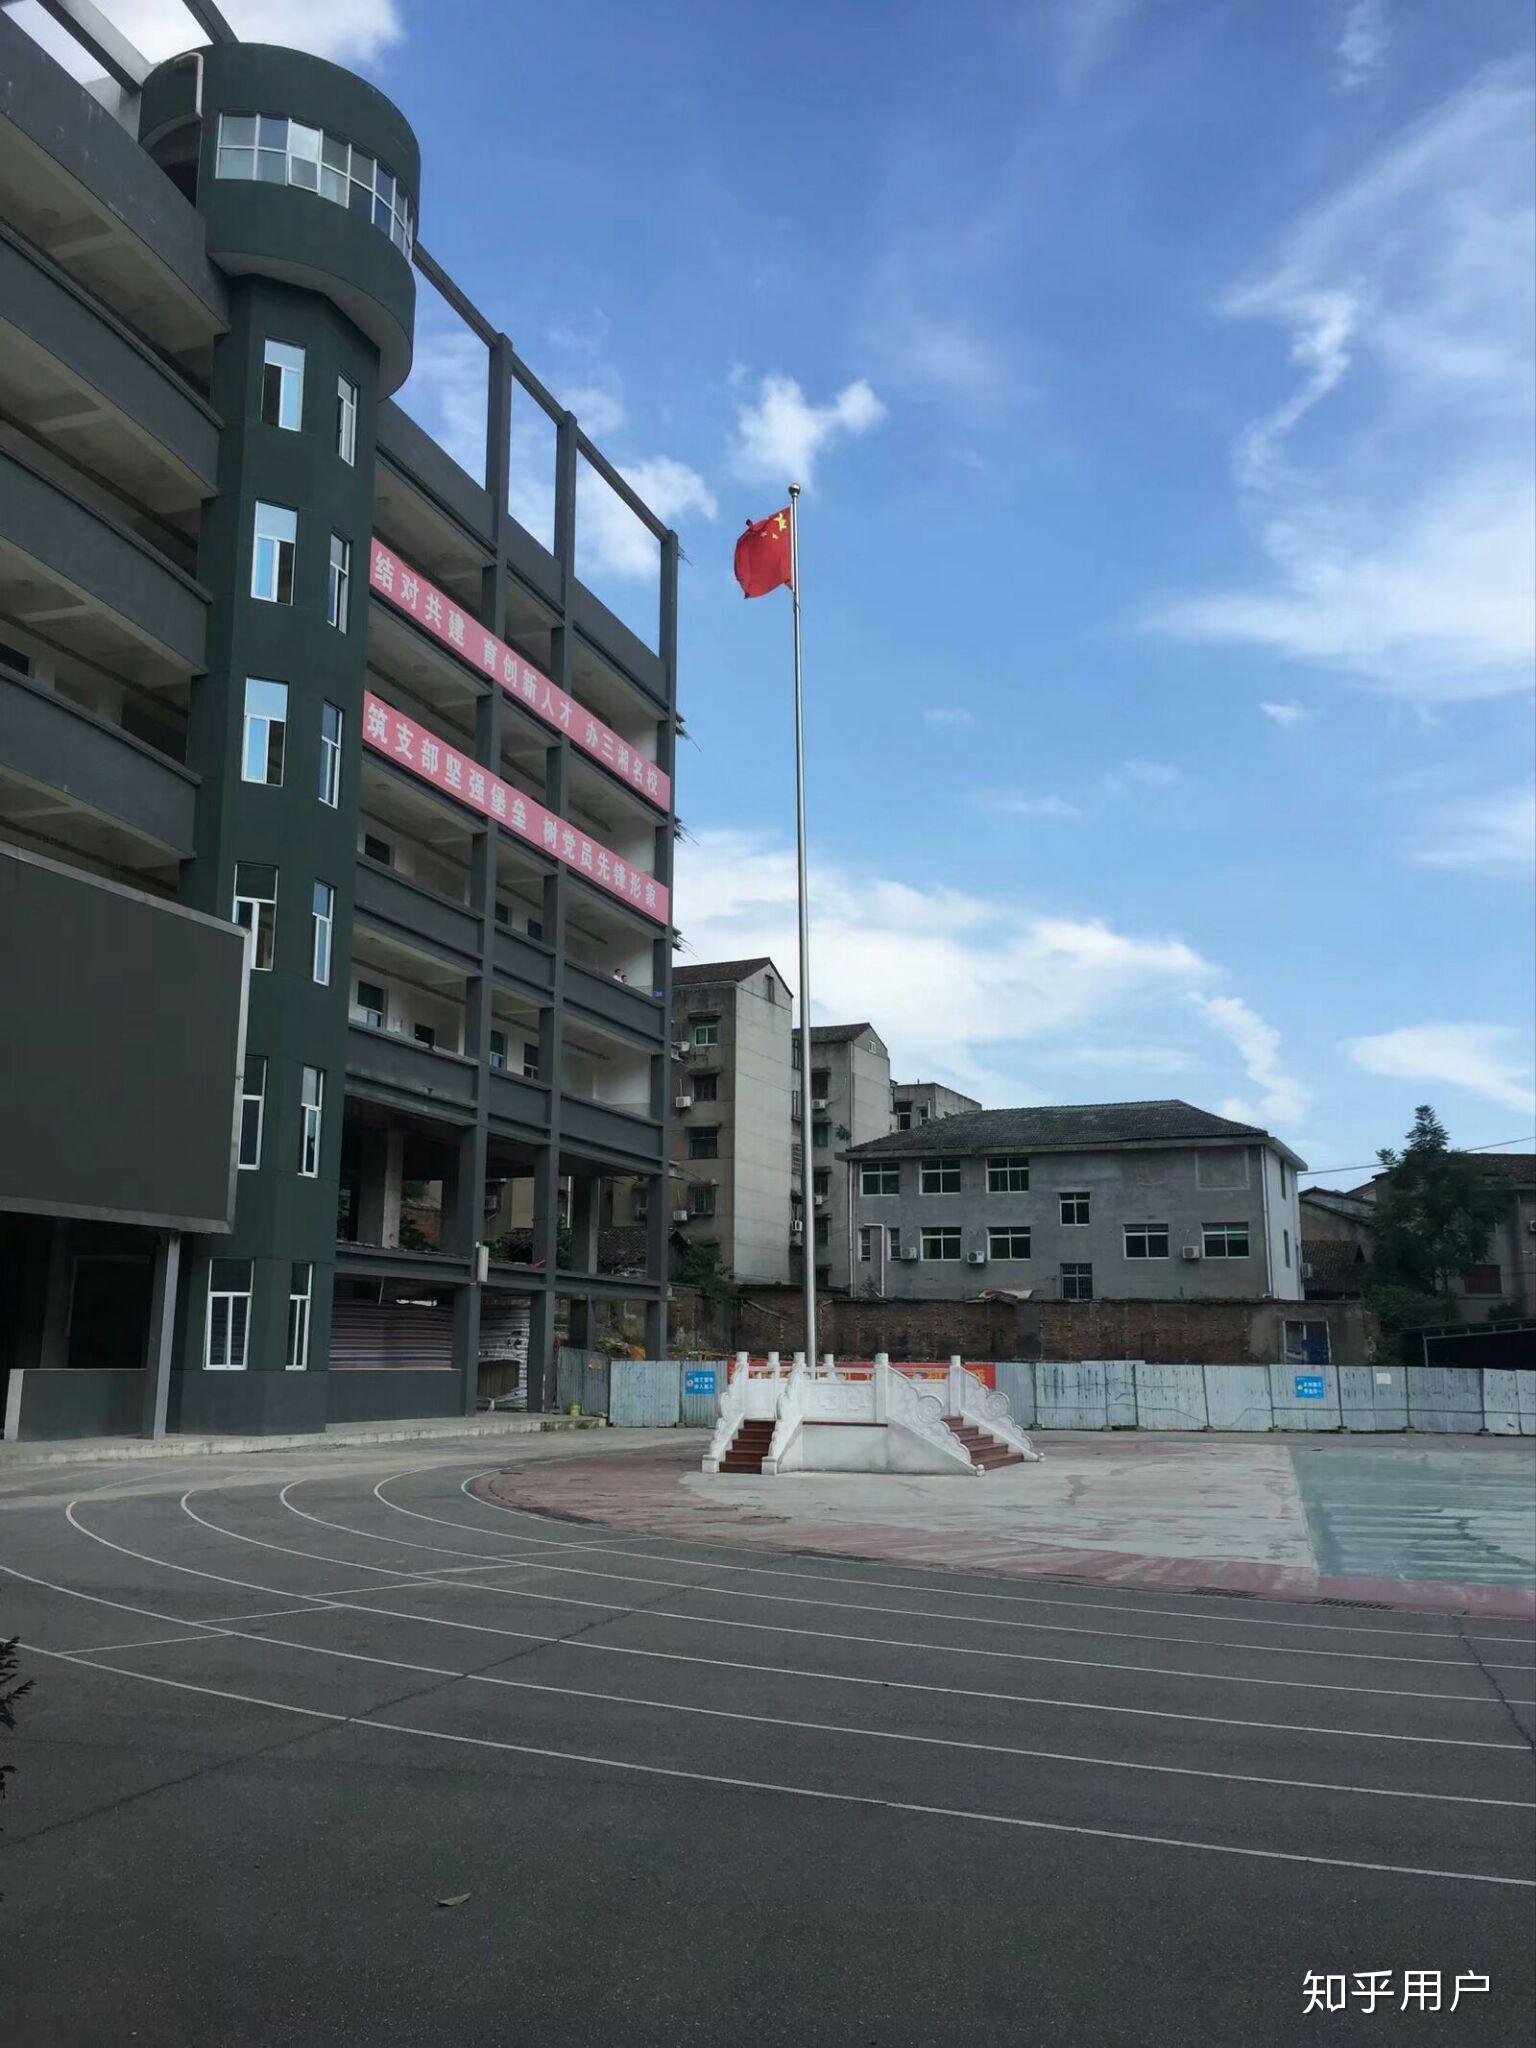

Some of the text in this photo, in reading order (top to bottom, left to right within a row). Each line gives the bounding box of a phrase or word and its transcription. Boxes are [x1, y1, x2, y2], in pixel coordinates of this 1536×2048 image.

[374, 551, 658, 797] 结对共建 育创新人才 办三湘名校
[366, 702, 657, 909] 筑支部坚强堡垒 树党员先锋形象
